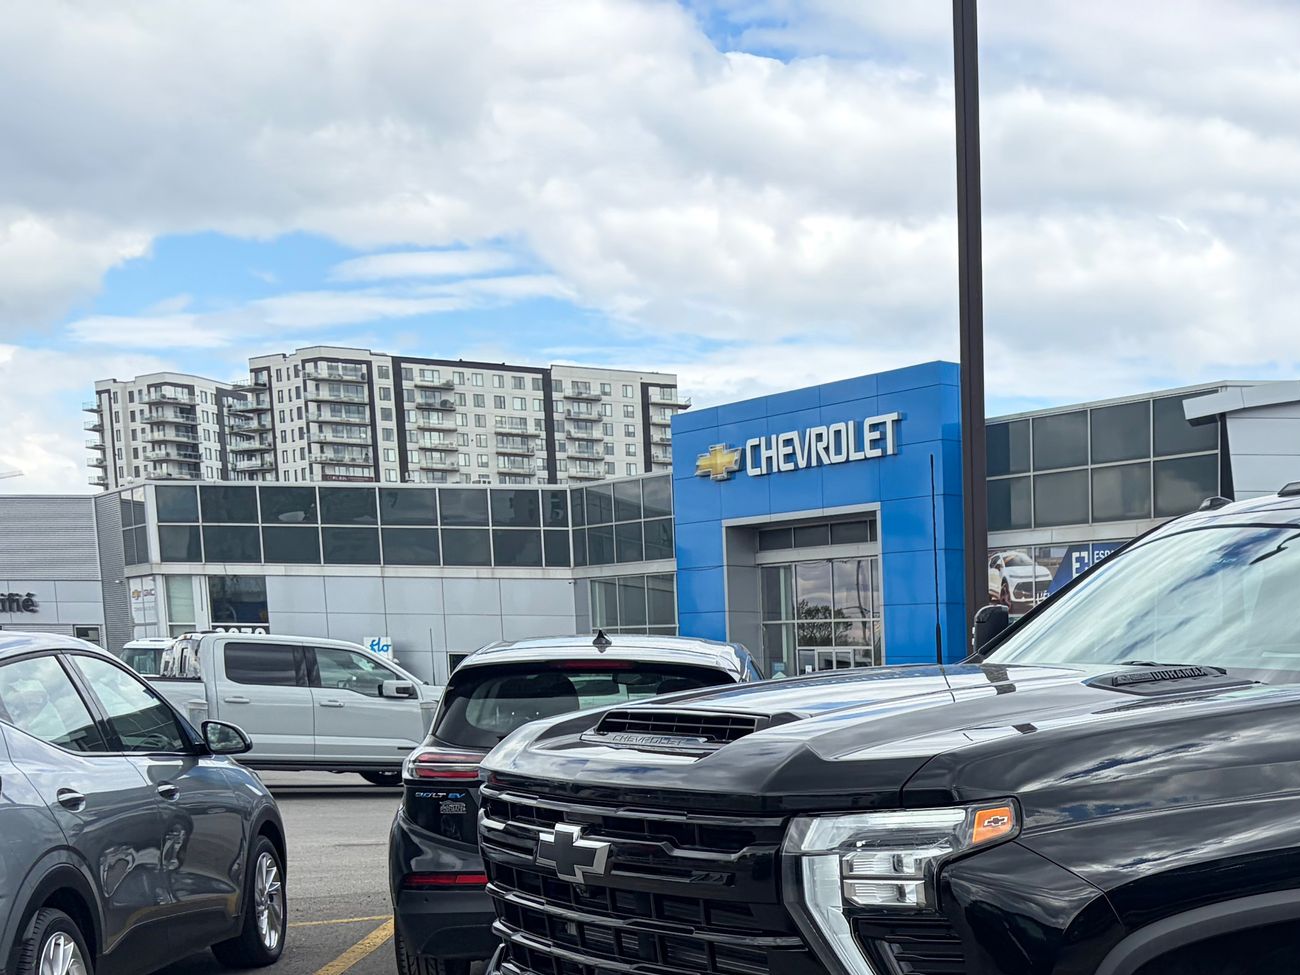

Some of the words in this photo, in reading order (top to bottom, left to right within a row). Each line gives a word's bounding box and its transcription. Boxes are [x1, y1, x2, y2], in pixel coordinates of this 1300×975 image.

[746, 411, 900, 477] CHEVROLET
[369, 637, 392, 653] flo
[612, 734, 686, 747] CHEVROLET
